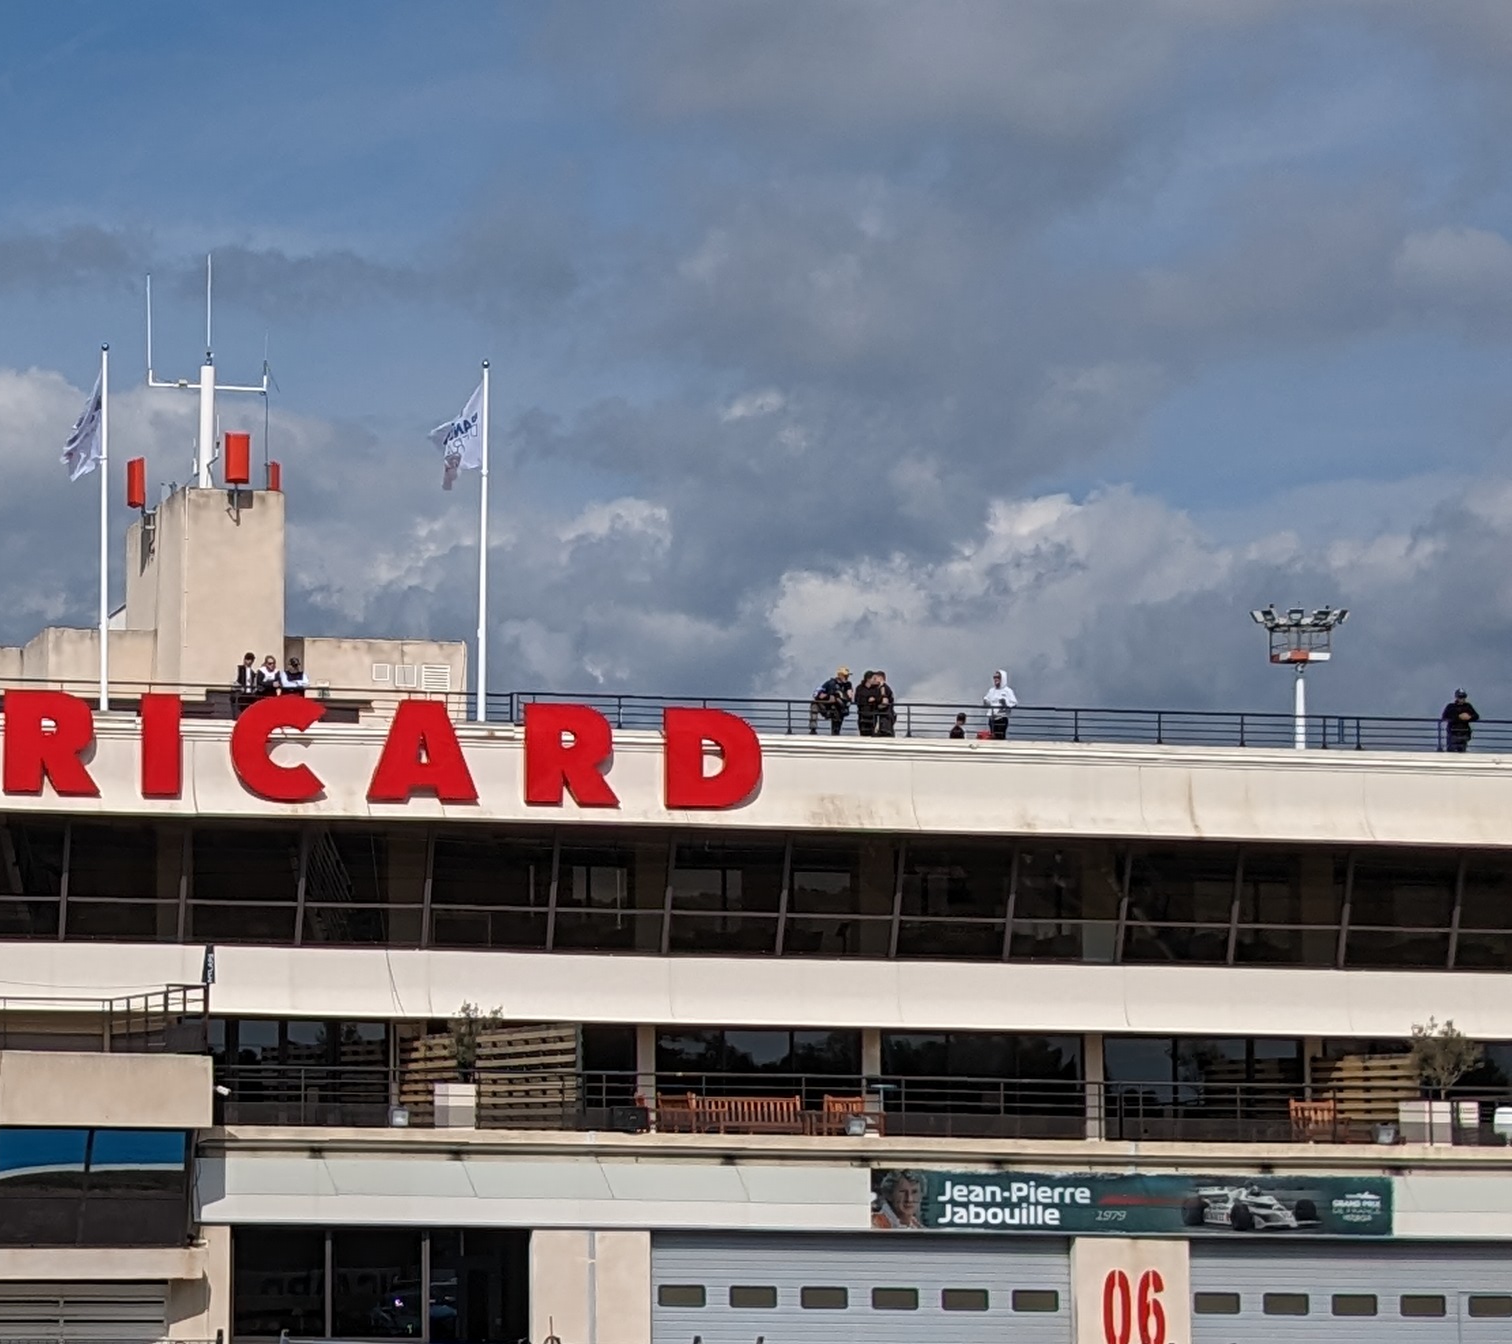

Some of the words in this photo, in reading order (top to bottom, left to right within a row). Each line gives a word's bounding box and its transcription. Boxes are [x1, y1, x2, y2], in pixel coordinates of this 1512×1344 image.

[2, 689, 764, 809] RICARD
[938, 1181, 1091, 1204] Jean-Pierre
[938, 1204, 1061, 1225] Jabouille
[1095, 1210, 1127, 1221] 1979
